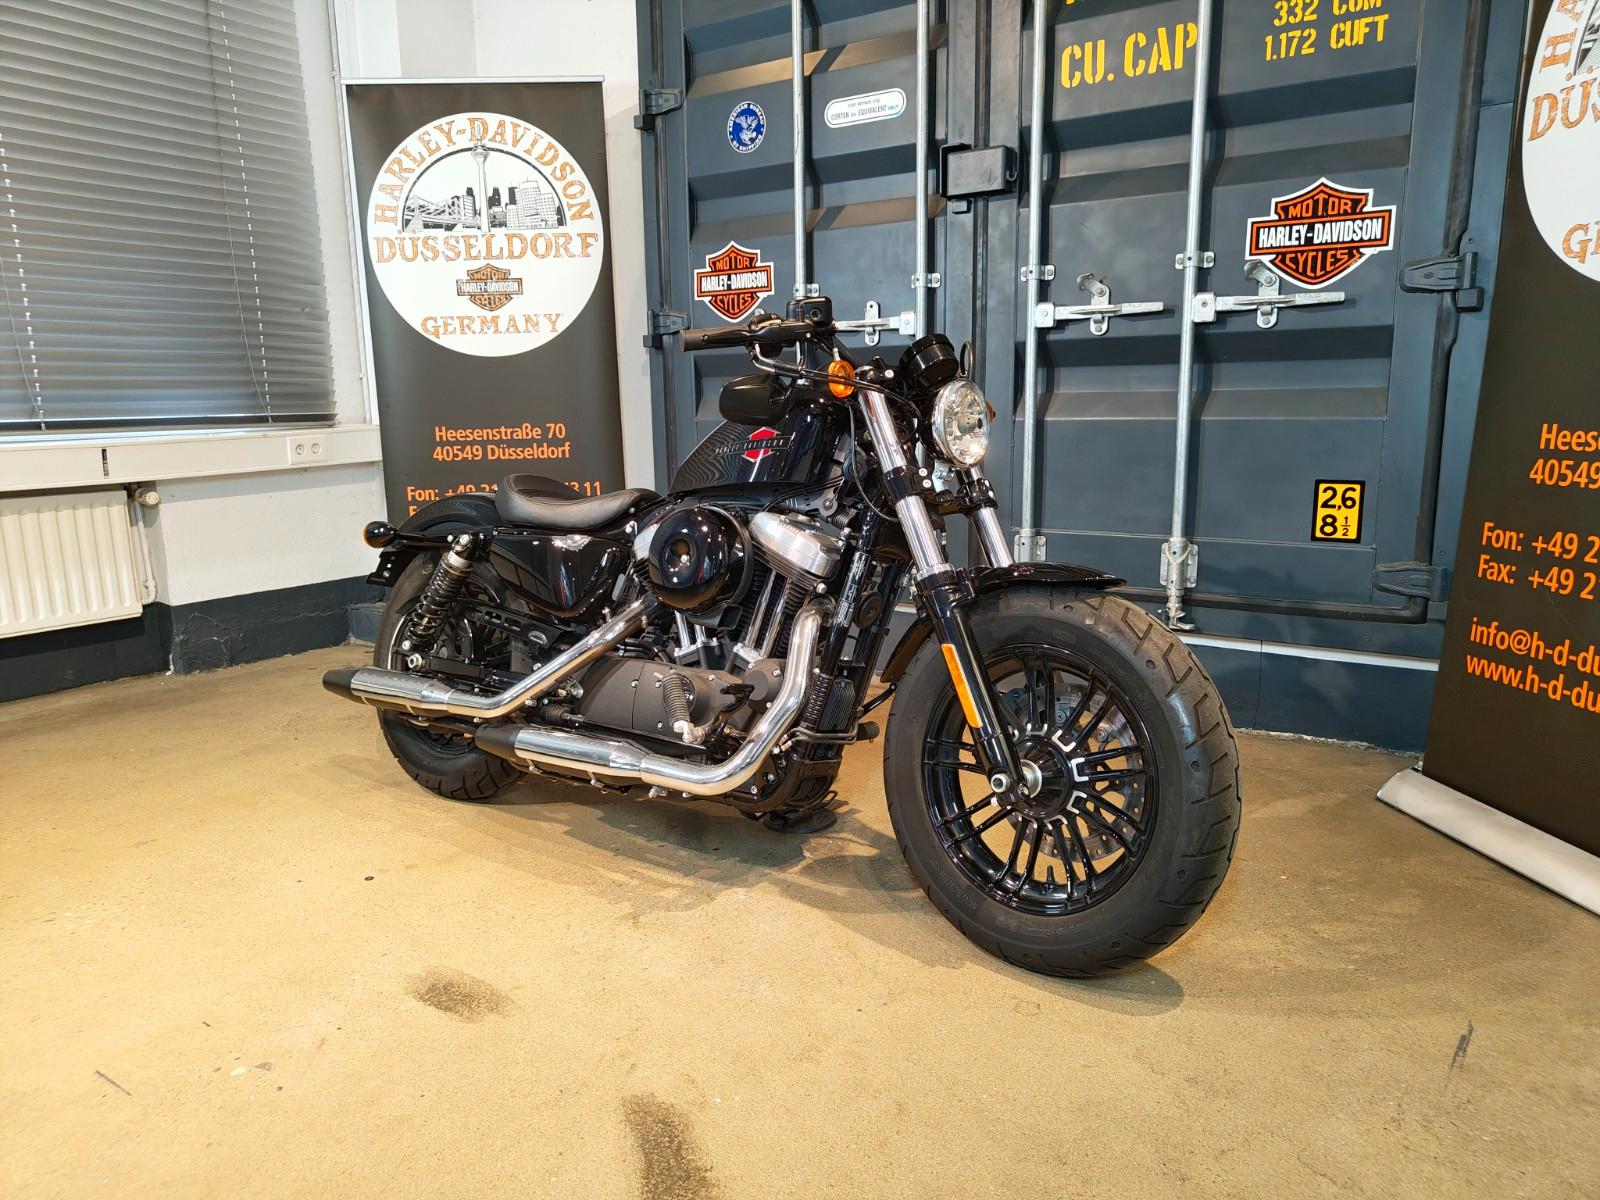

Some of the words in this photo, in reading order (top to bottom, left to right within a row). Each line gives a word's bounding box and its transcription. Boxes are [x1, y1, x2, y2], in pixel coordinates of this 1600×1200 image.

[1273, 0, 1319, 27] 332
[1265, 27, 1318, 61] 1.172
[1330, 13, 1390, 49] CUFT
[1061, 39, 1115, 89] CU.
[1123, 22, 1198, 78] CAP
[858, 105, 887, 117] EQUIVALENT
[374, 117, 595, 226] HARLEY-DAVIDSON
[1288, 192, 1352, 219] MOTOR
[374, 228, 599, 263] DÜSSELDORF
[1258, 218, 1383, 249] HARLEY-DAVIDSON
[716, 252, 750, 271] MOTOR
[1285, 249, 1349, 277] CYCLES
[701, 270, 768, 292] HARLEY-DAVIDSON
[716, 293, 752, 314] CYCLES
[420, 313, 562, 339] GERMANY
[434, 422, 542, 441] Heesenstraße
[545, 423, 566, 439] 70
[433, 445, 483, 461] 40549
[487, 441, 571, 460] Düsseldorf
[1529, 458, 1600, 490] 40549
[407, 486, 439, 501] Fon:
[1320, 486, 1357, 511] 2,6
[1482, 522, 1524, 552] Fon:
[1531, 531, 1578, 560] +49
[1477, 554, 1517, 585] Fax:
[1528, 566, 1574, 595] +49
[1466, 655, 1600, 713] www.h-d-du
